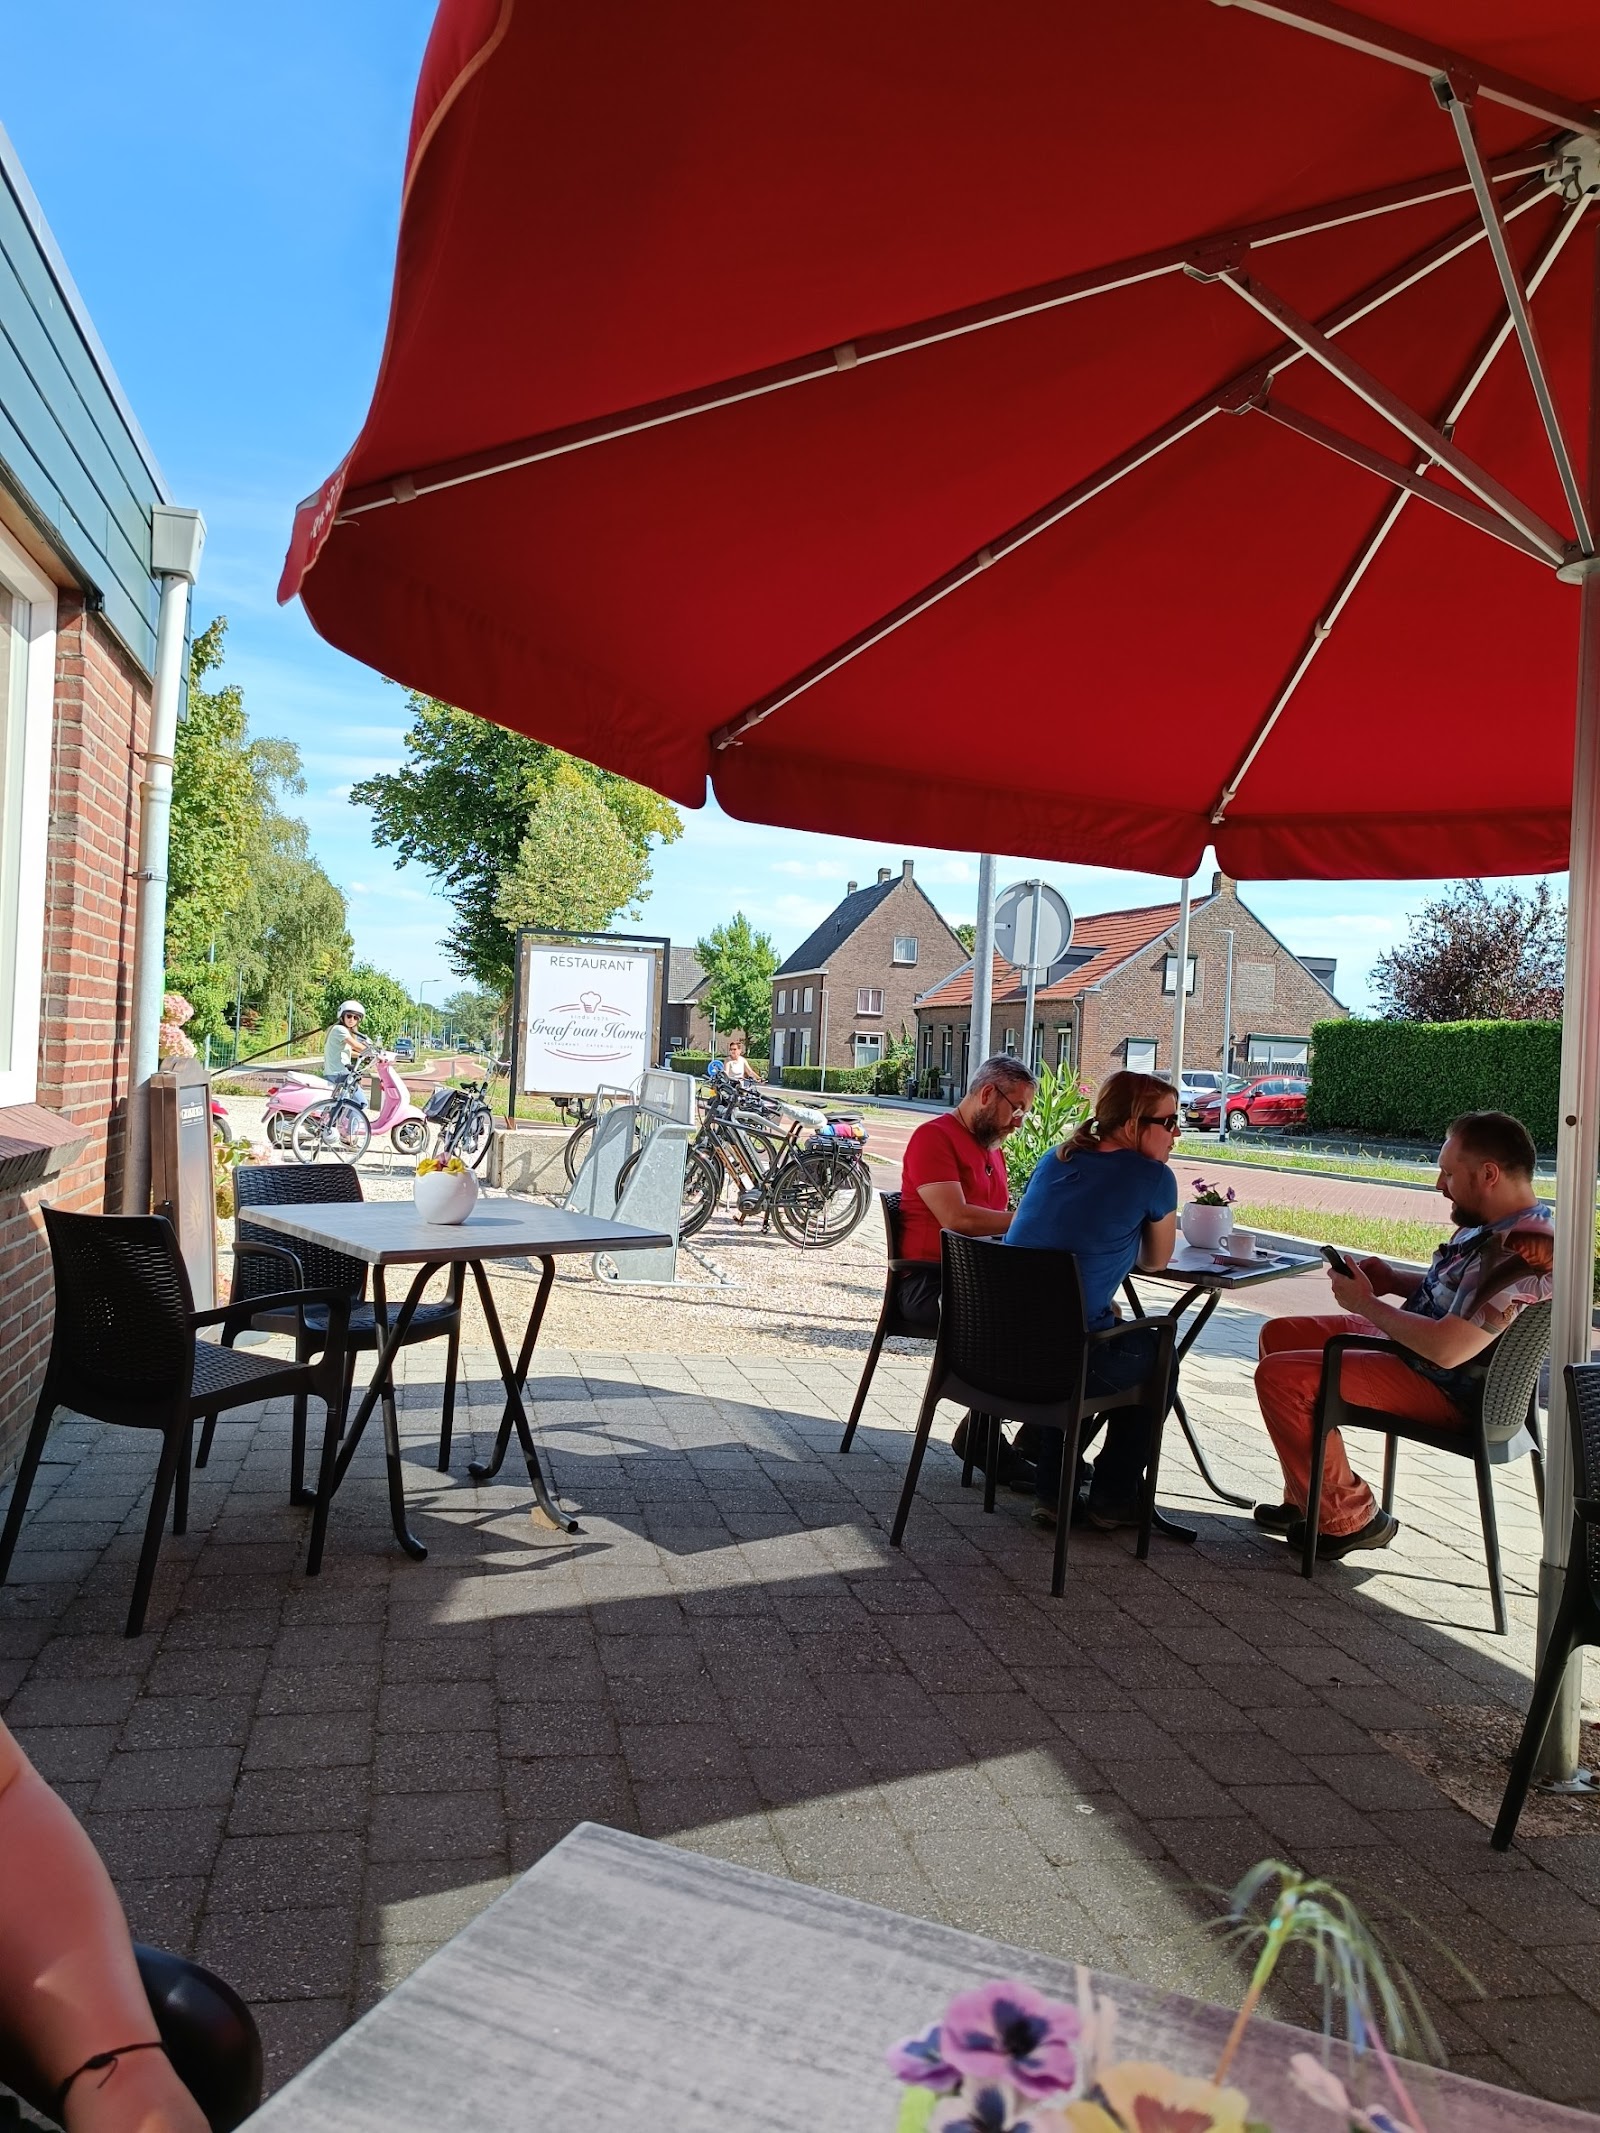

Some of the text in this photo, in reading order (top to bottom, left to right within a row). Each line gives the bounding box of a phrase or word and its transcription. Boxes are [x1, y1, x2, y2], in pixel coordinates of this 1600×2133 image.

[550, 955, 634, 971] RESTAURANT
[529, 1018, 647, 1041] Graaf van Horne
